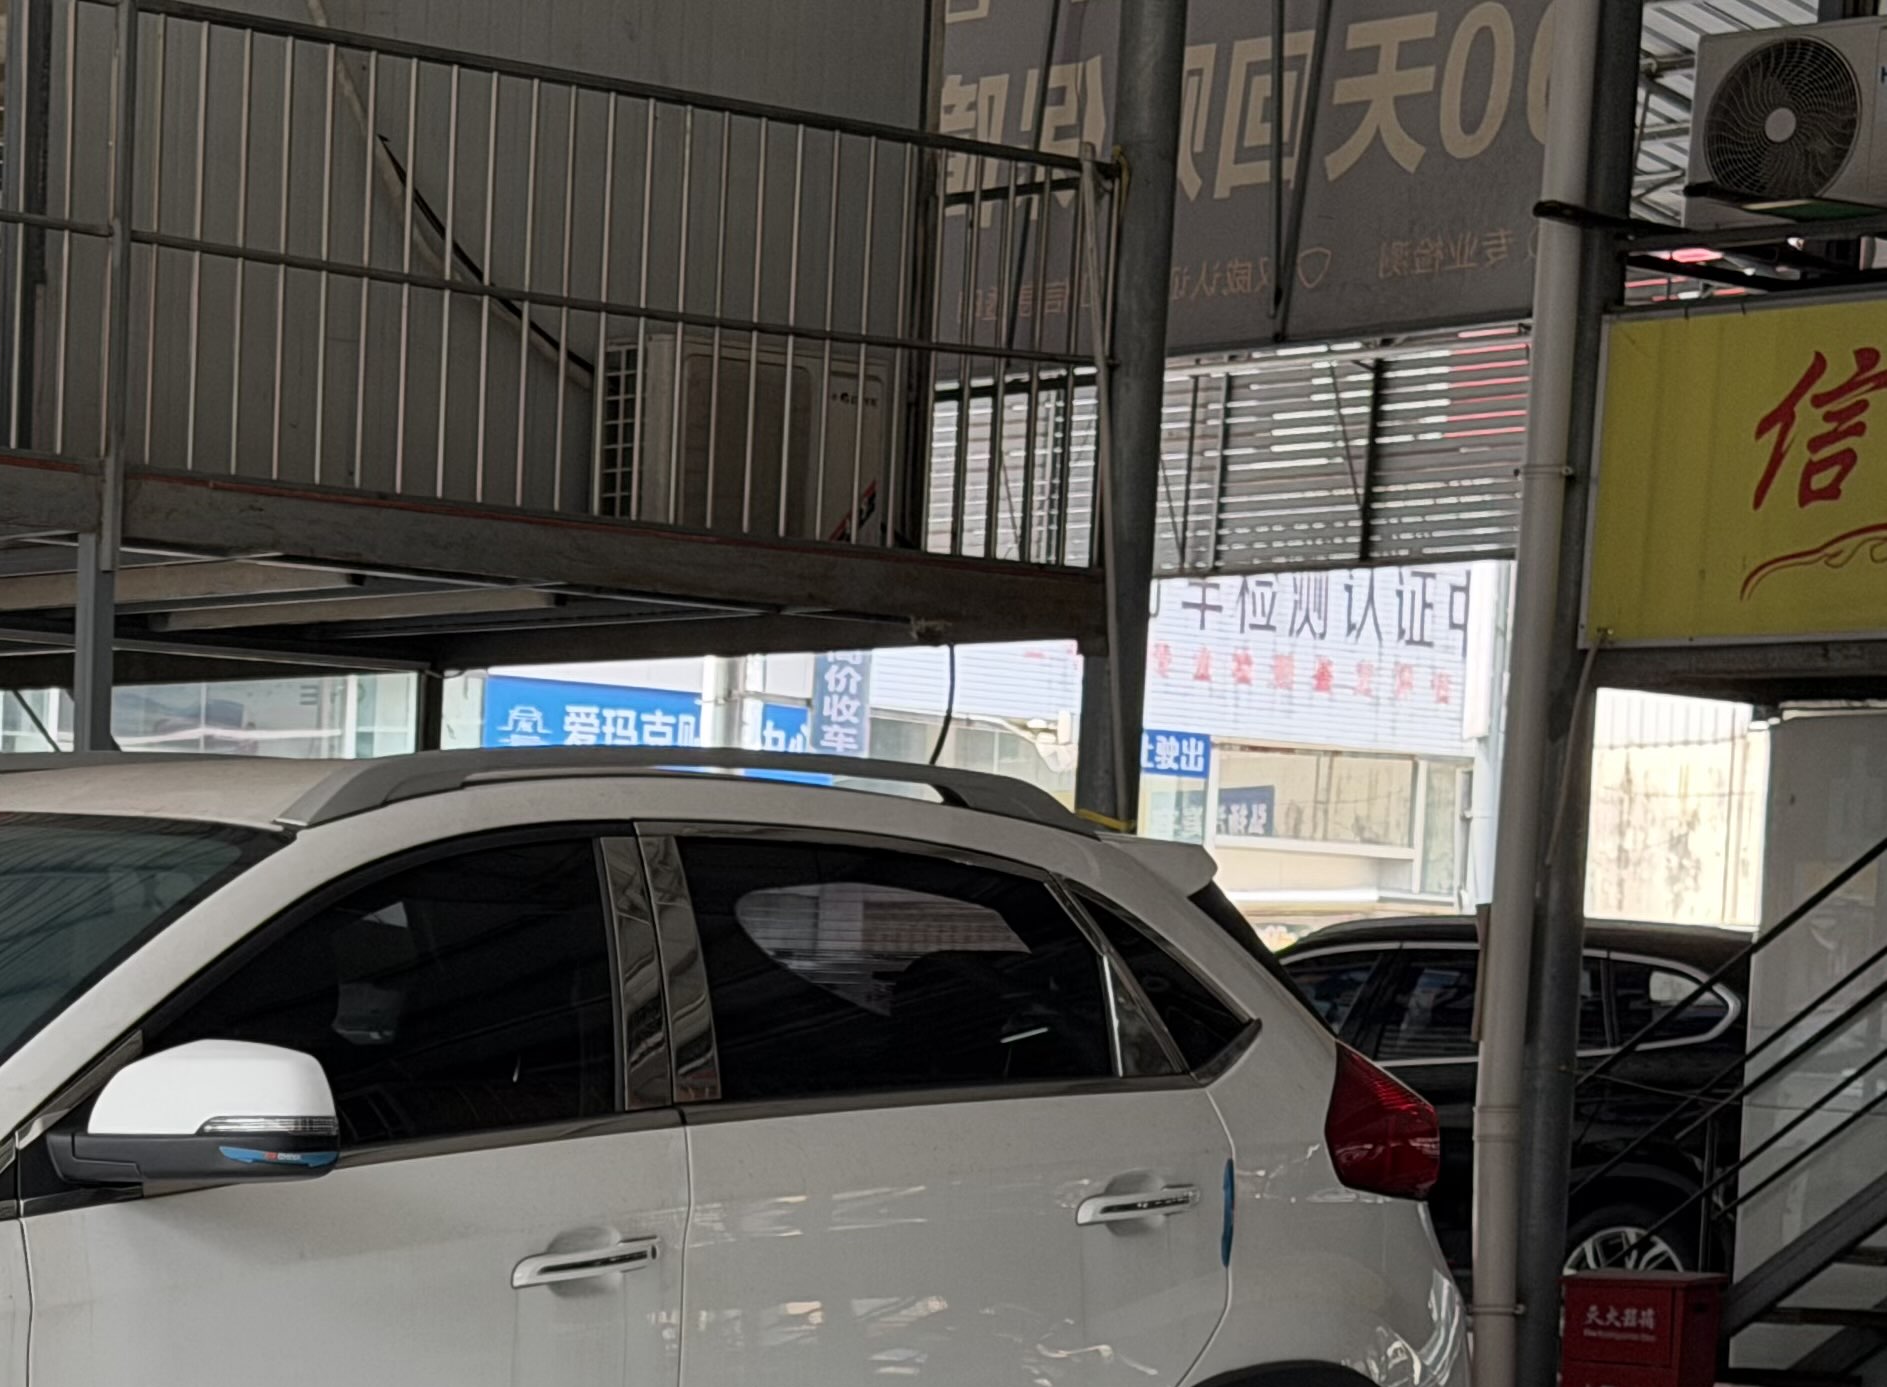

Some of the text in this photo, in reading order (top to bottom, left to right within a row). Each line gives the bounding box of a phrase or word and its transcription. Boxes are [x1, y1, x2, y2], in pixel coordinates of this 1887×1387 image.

[1753, 347, 1887, 511] 信
[1584, 1305, 1655, 1329] 灭火器箱
